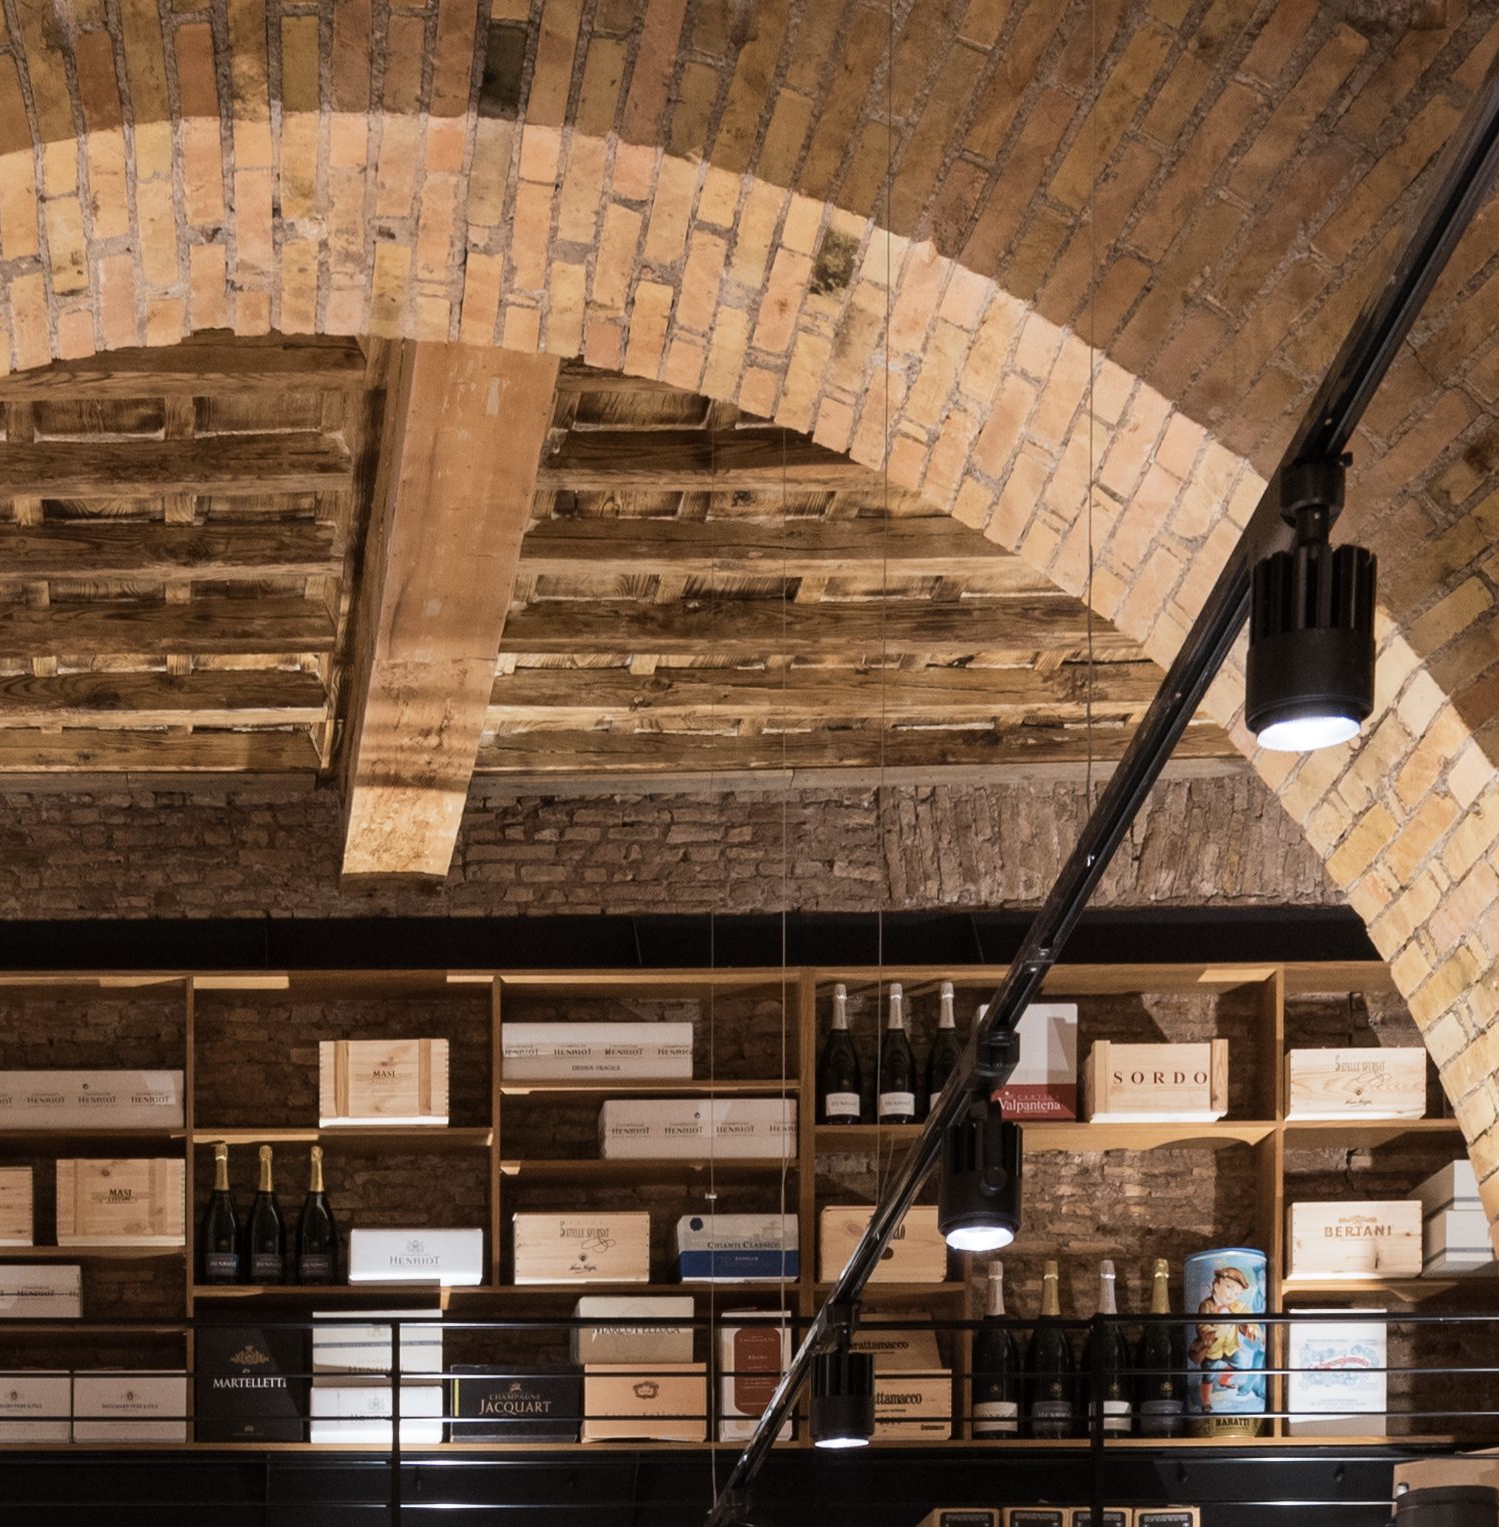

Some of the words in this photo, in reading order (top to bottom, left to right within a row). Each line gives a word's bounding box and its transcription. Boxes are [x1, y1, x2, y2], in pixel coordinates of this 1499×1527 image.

[553, 1048, 592, 1056] HENRIOT
[604, 1048, 643, 1056] HENRIOT
[372, 1069, 397, 1079] MASI
[1112, 1070, 1209, 1085] SORDO
[26, 1096, 65, 1105] HENRIOT
[77, 1096, 117, 1105] HENRIOT
[130, 1096, 170, 1105] HENRIOT
[997, 1097, 1062, 1113] Valpantena
[611, 1127, 650, 1135] HENRIOT
[664, 1126, 703, 1135] HENRIOT
[716, 1125, 755, 1134] HENRIOT
[108, 1188, 133, 1199] MASI
[1324, 1225, 1393, 1238] BERTANI
[707, 1241, 742, 1250] CHIANTI
[742, 1241, 781, 1250] CLASSICO
[389, 1255, 441, 1265] HENRIOT
[212, 1376, 288, 1390] MARTELLETTI
[487, 1393, 542, 1401] CHAMPAGNE
[478, 1400, 552, 1416] JACQUART
[1214, 1418, 1251, 1428] BARATTI
